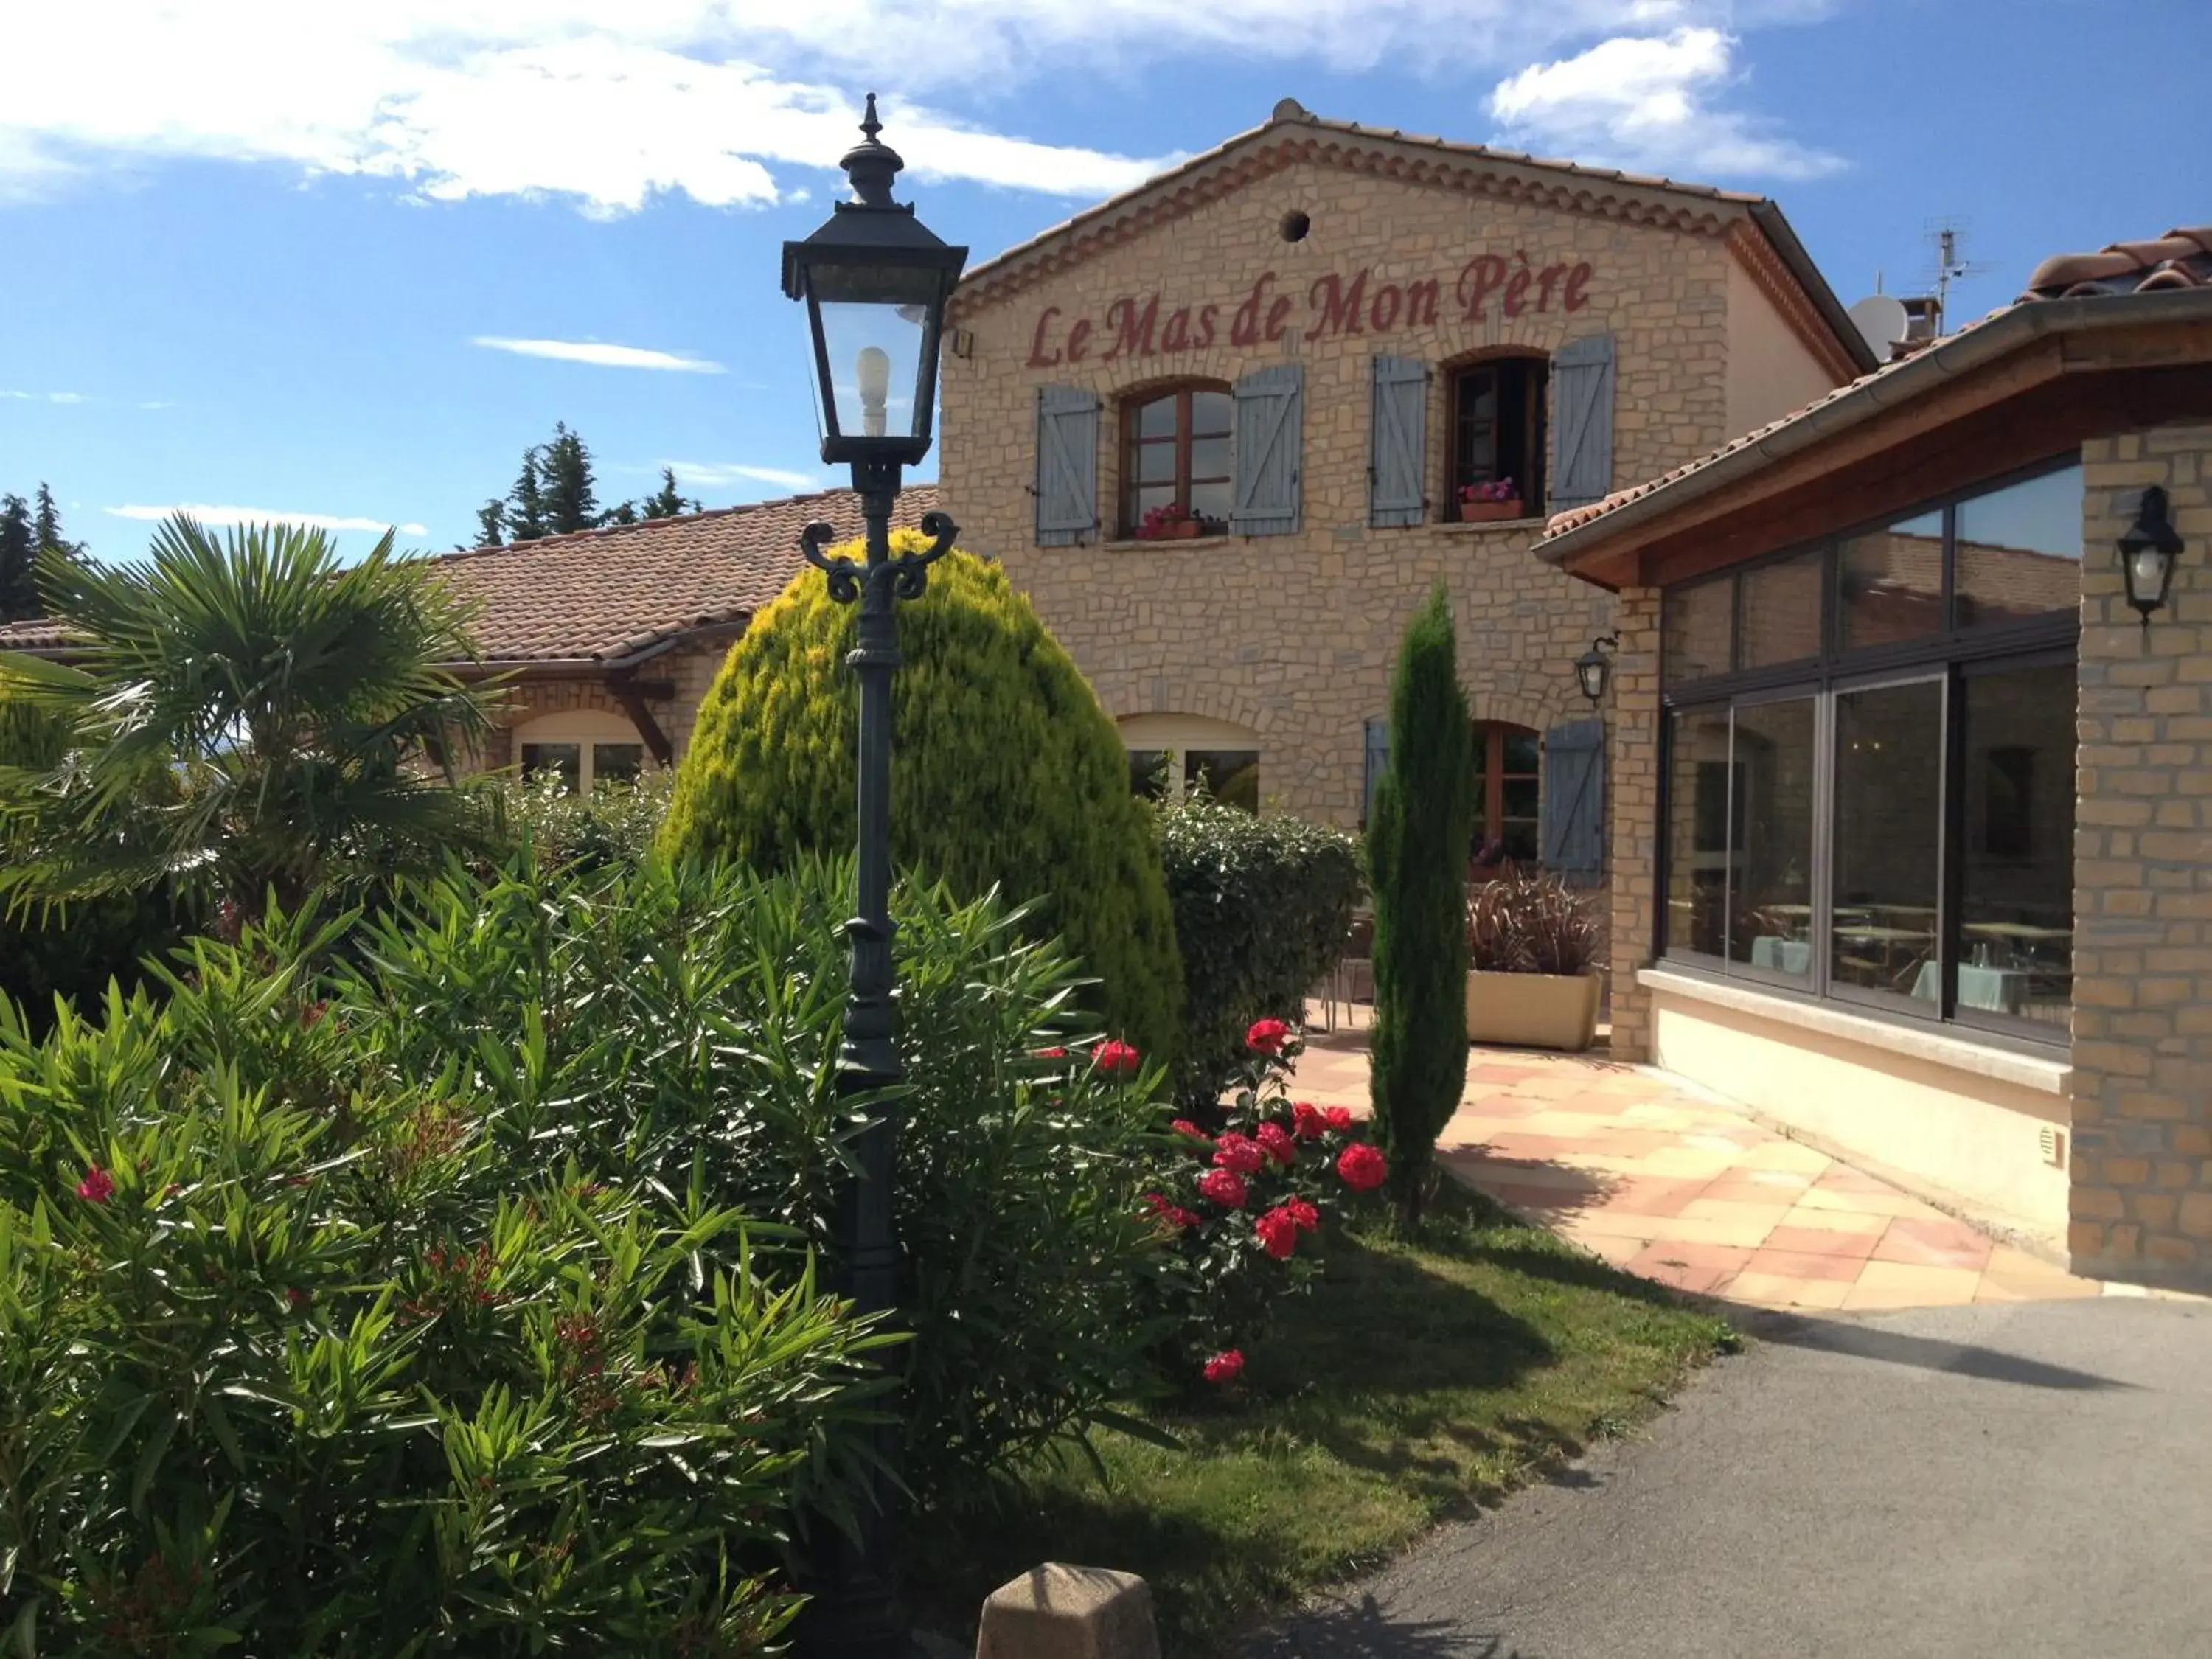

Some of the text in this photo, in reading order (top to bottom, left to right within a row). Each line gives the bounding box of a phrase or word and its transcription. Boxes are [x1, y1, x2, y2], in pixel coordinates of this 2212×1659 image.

[1026, 250, 1592, 369] Le Mas de Mon Père
